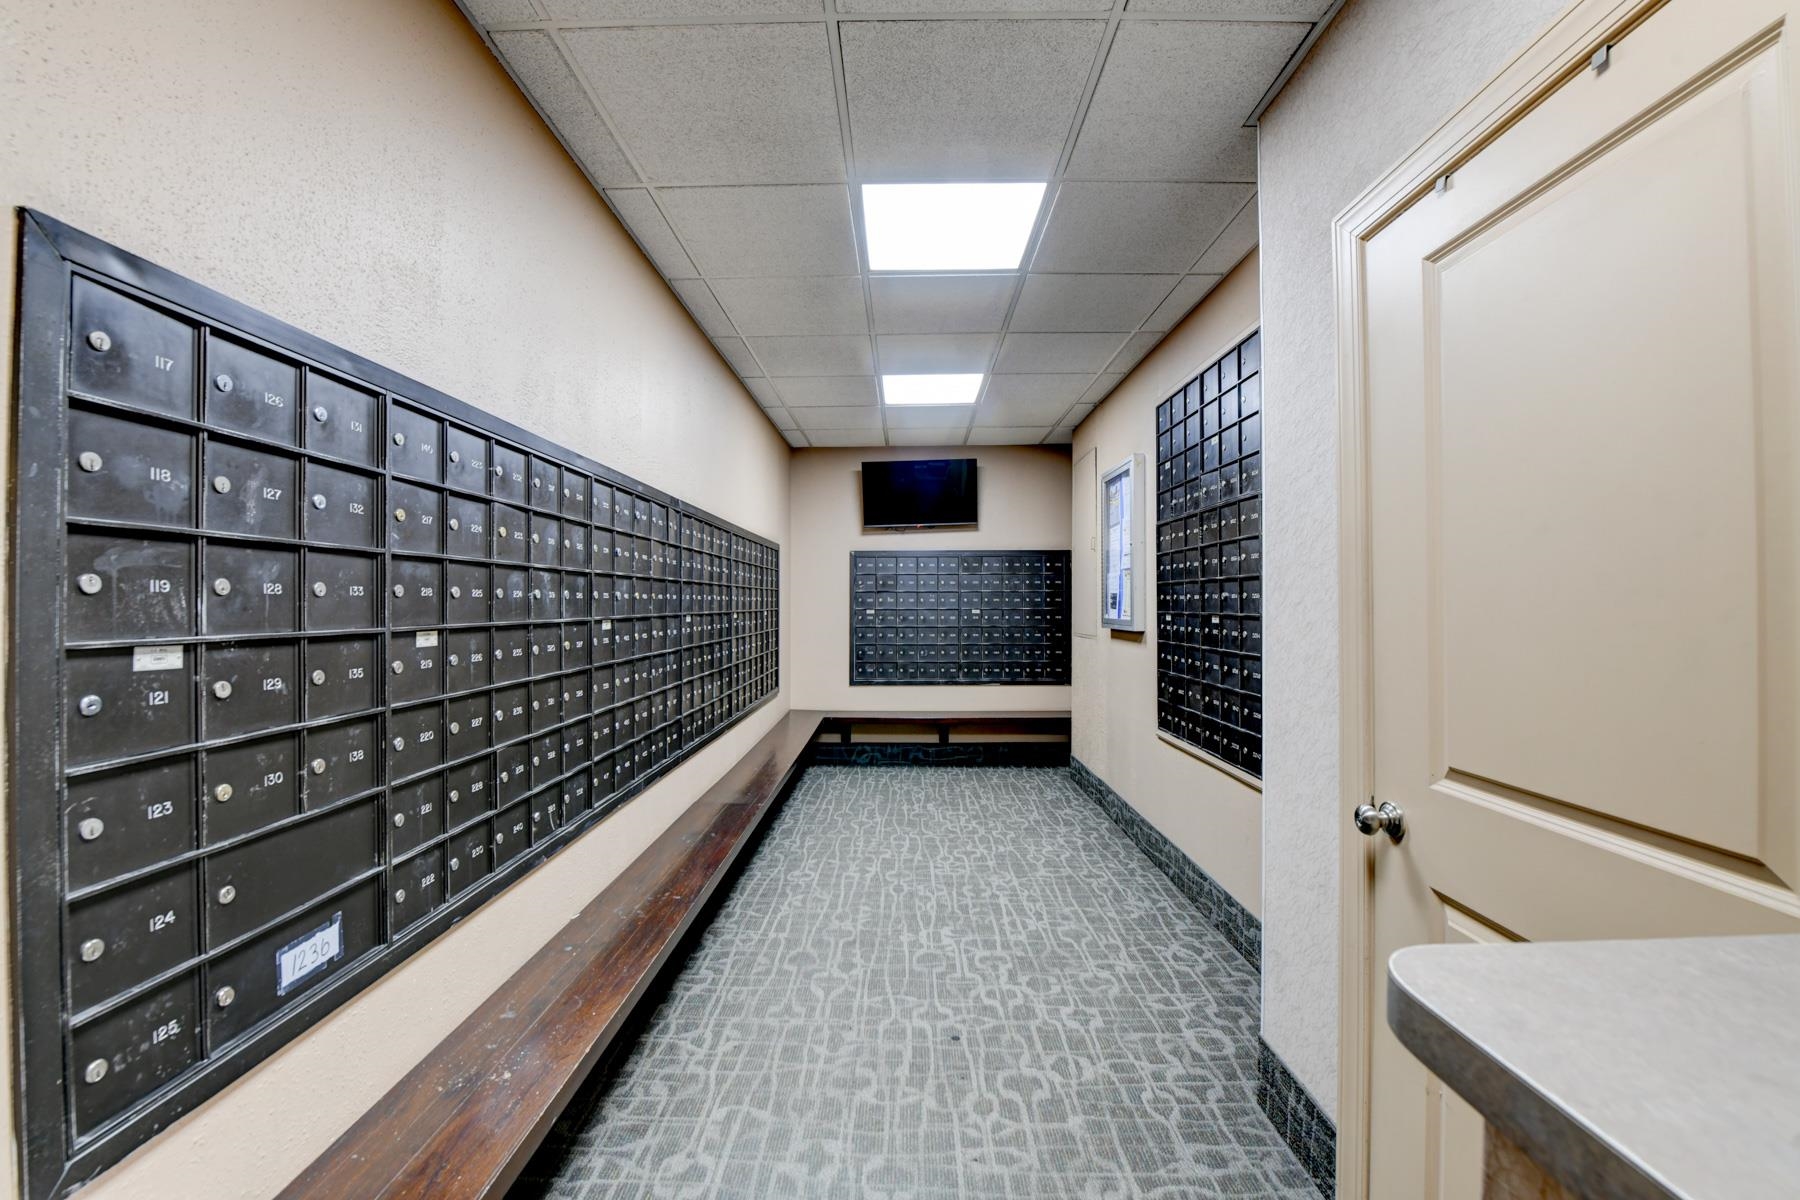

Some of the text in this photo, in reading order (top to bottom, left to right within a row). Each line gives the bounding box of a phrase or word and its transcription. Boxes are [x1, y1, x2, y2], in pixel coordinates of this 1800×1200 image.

[155, 356, 174, 371] 117
[264, 393, 284, 408] 126
[350, 421, 362, 433] 131
[150, 468, 172, 482] 118
[263, 488, 282, 501] 127
[349, 503, 364, 514] 132
[150, 580, 171, 593] 119
[263, 583, 282, 595] 128
[350, 586, 364, 596] 133
[420, 659, 433, 669] 219
[349, 668, 364, 679] 135
[263, 678, 282, 691] 129
[149, 692, 169, 705] 121
[471, 717, 483, 727] 227
[420, 731, 434, 743] 220
[264, 772, 283, 787] 130
[148, 801, 173, 819] 123
[421, 802, 433, 815] 221
[421, 873, 435, 887] 222
[149, 910, 175, 932] 124
[290, 937, 330, 977] 1236
